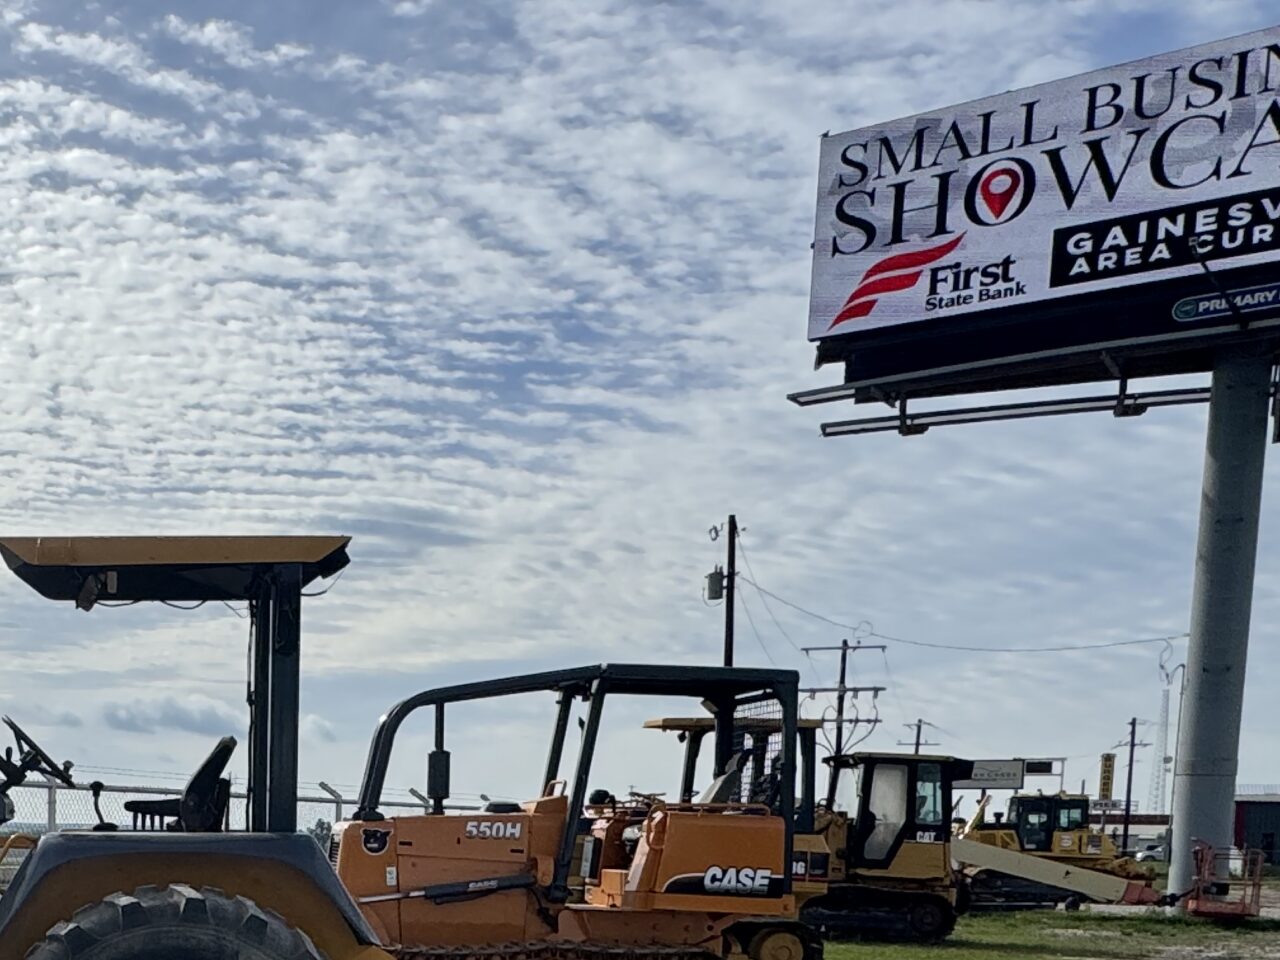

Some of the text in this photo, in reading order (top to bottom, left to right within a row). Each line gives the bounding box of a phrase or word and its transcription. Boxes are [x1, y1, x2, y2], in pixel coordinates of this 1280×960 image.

[837, 99, 1058, 188] SMALL
[1069, 223, 1274, 276] AREA CUR
[927, 253, 1016, 297] First
[925, 281, 1026, 312] State Bank
[465, 821, 521, 839] 550H
[916, 831, 936, 842] CAT
[704, 866, 771, 894] CASE
